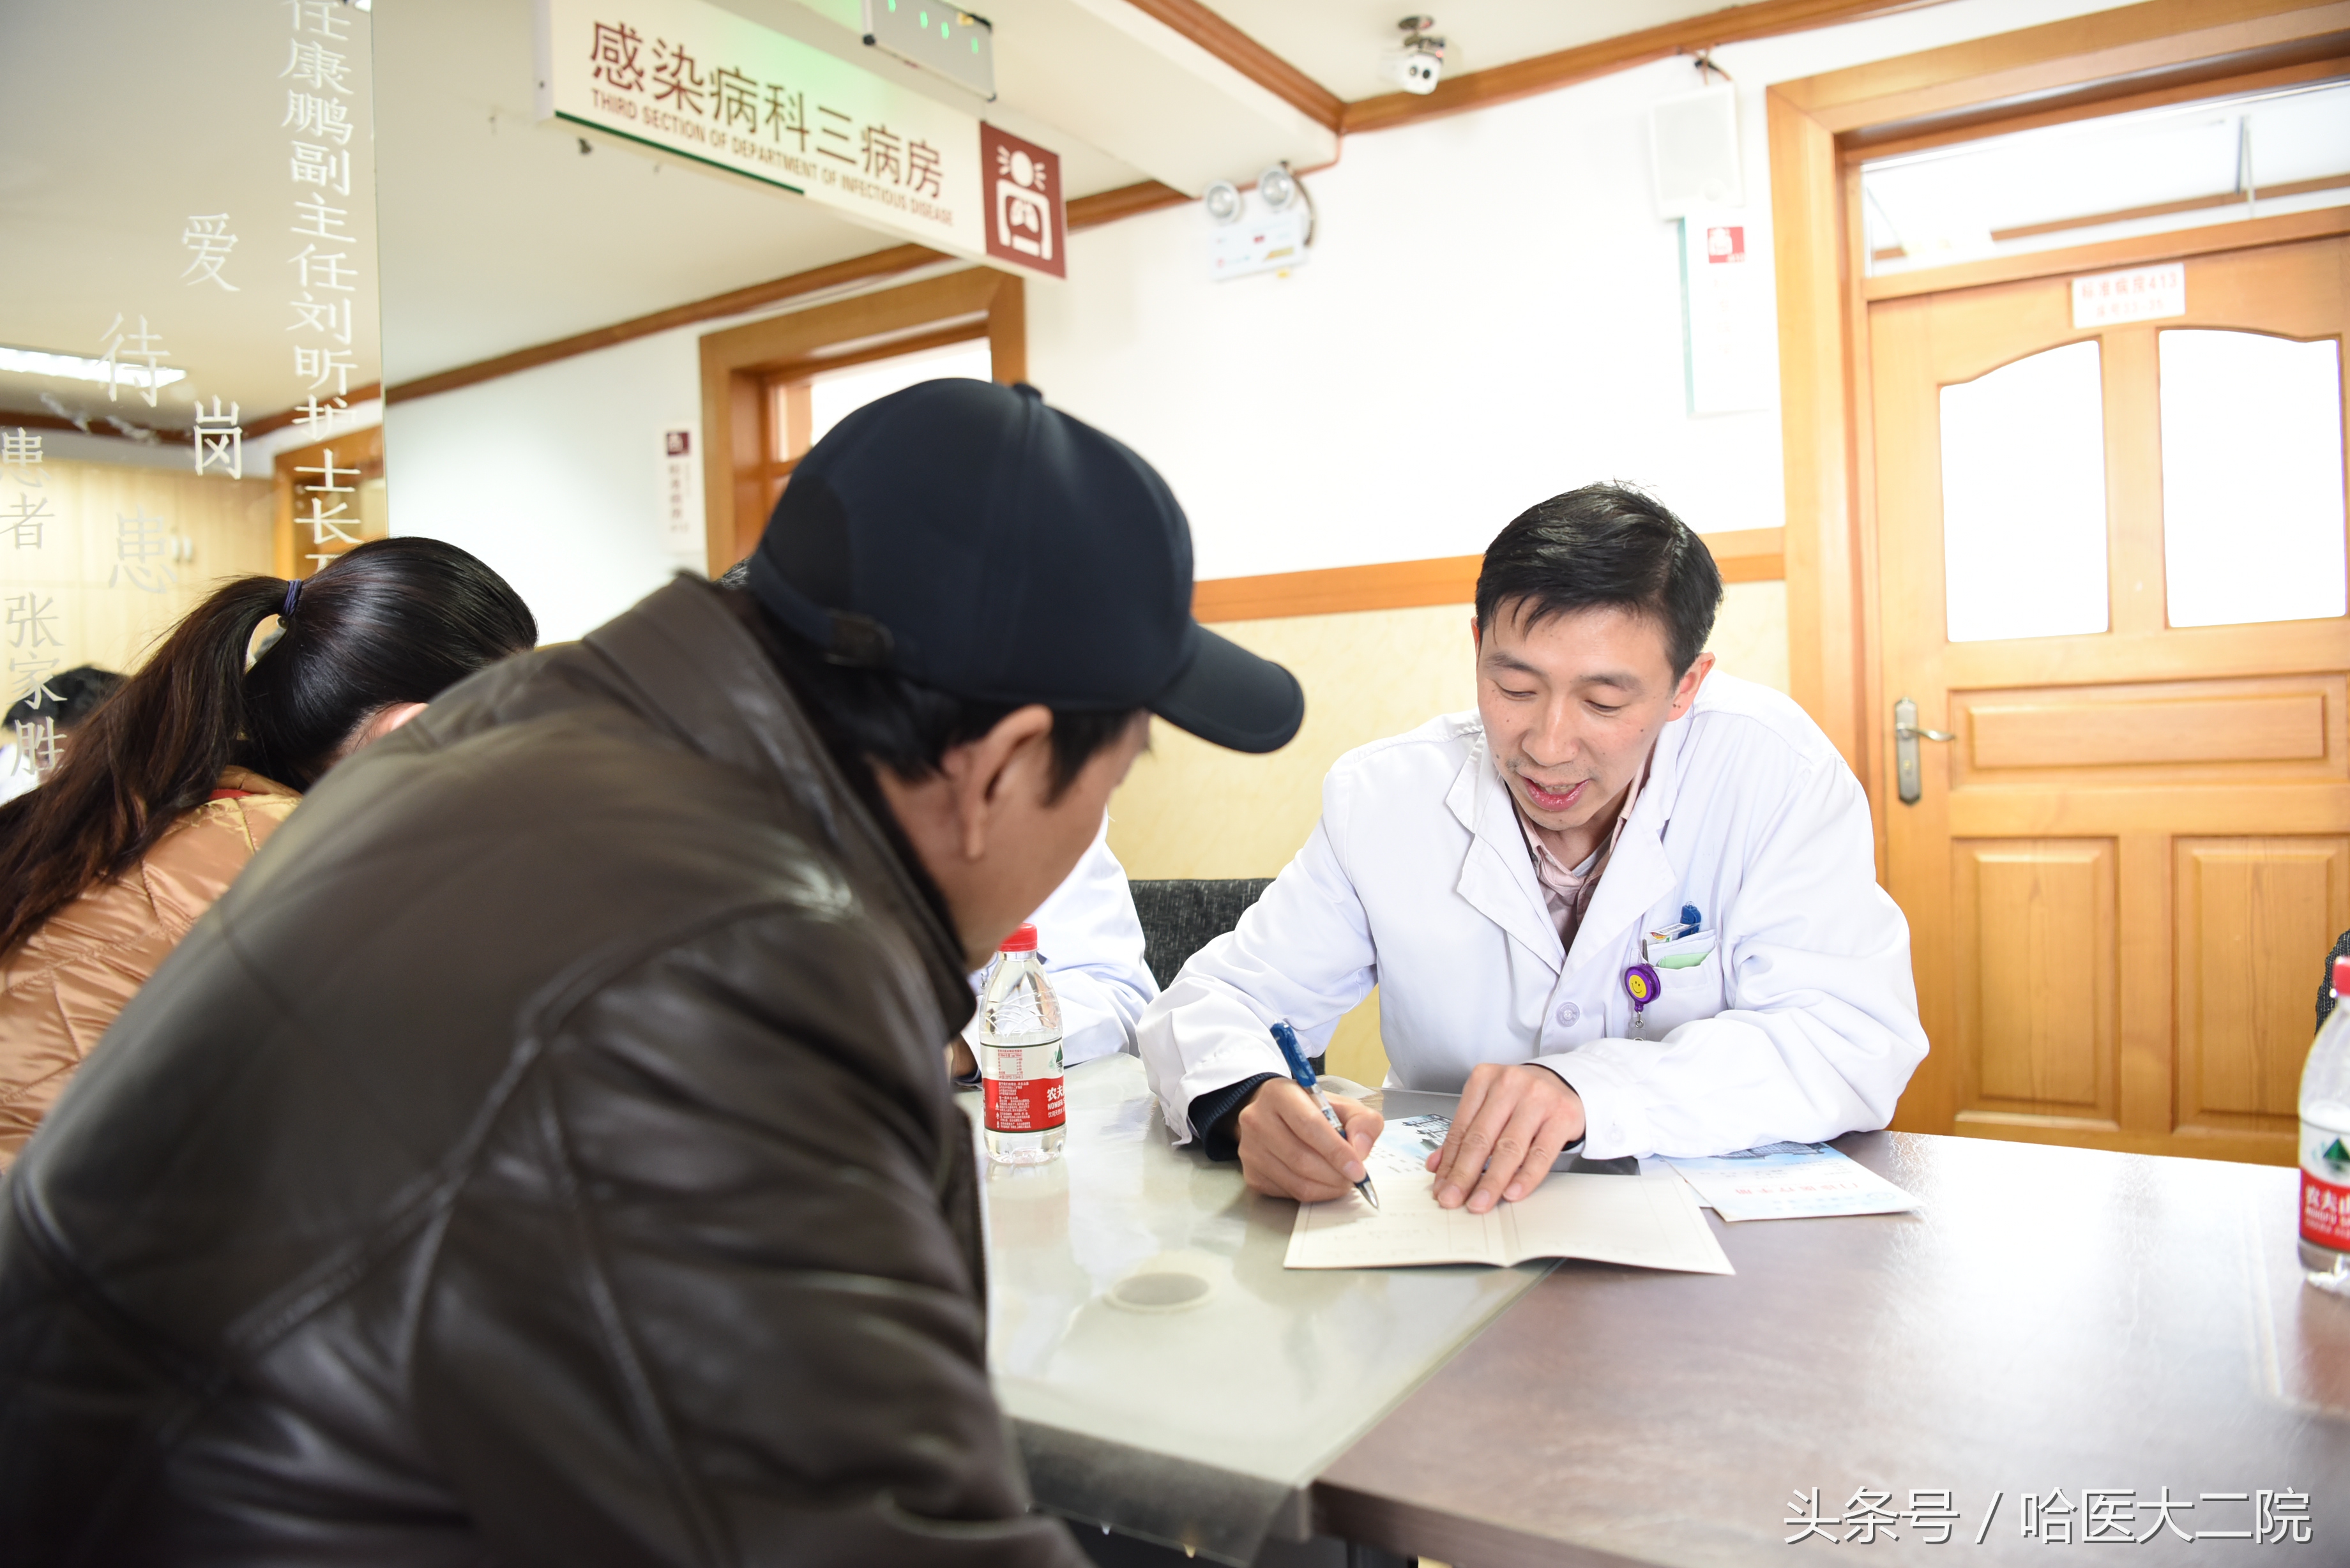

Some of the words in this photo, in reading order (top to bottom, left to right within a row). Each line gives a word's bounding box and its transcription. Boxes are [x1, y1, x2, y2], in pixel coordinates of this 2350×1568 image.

[590, 22, 944, 199] 感染病科三病房
[593, 88, 637, 119] THIRD
[643, 106, 705, 142] SECTION
[710, 128, 727, 149] OF
[732, 137, 817, 179] DEPARTMENT
[822, 167, 837, 185] OF
[842, 175, 907, 211] INFECTIOUS
[911, 199, 953, 227] DISEASE
[0, 427, 56, 550] 患者
[5, 591, 68, 776] 张家胜
